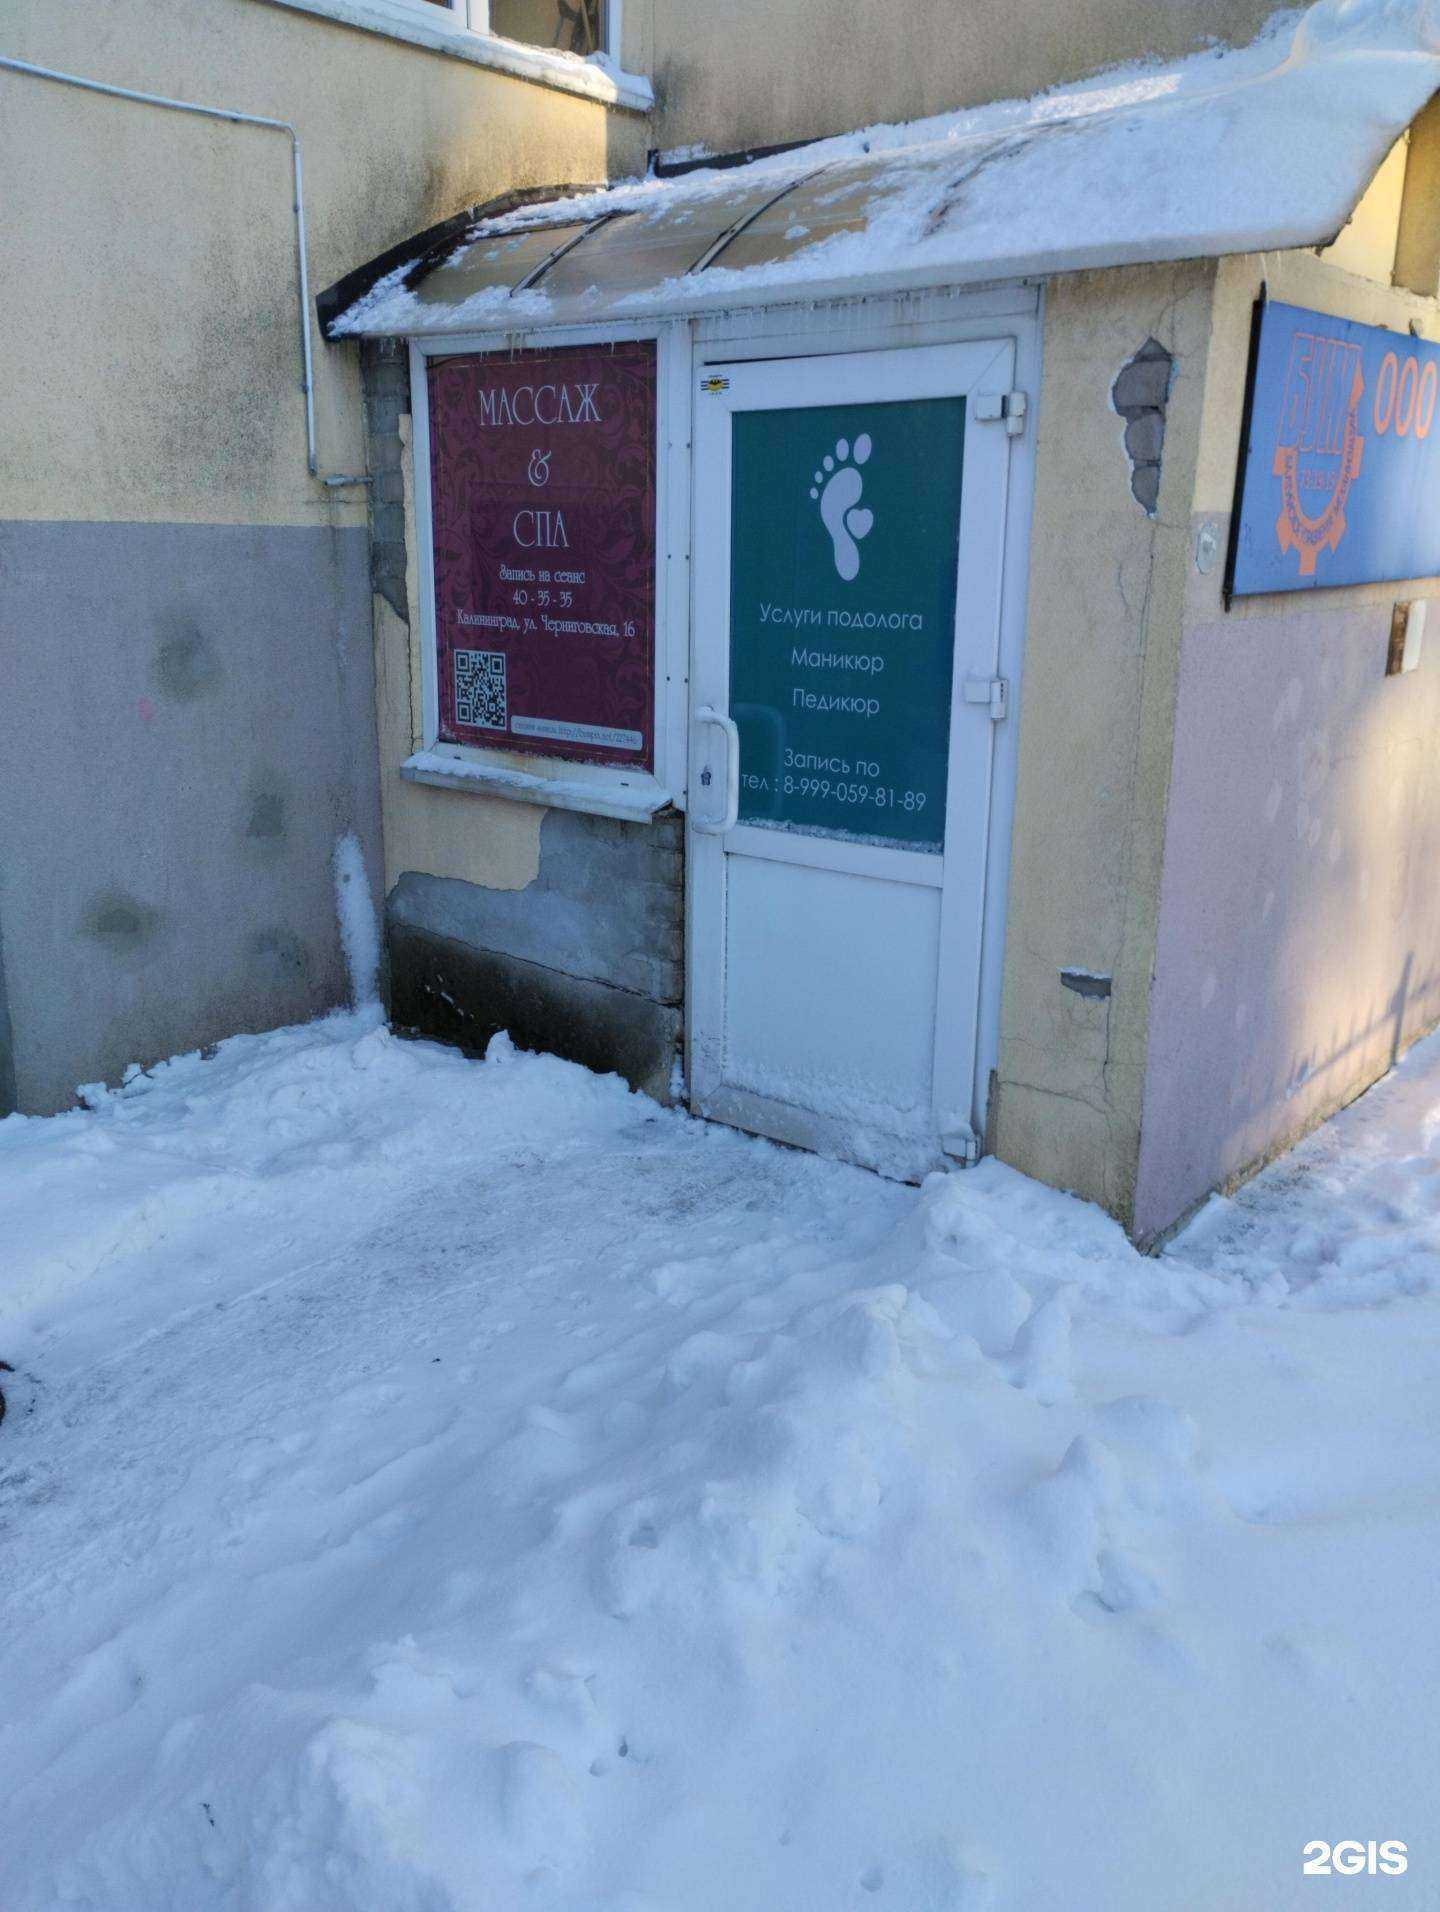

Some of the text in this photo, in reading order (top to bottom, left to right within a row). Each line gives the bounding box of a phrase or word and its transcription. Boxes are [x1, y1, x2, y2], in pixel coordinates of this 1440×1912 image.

[478, 383, 602, 426] МАССАЖ
[528, 448, 552, 487] &
[513, 510, 570, 548] СПА
[499, 564, 586, 584] Запись на сеанс
[623, 620, 636, 638] 16
[759, 603, 924, 631] Услуги подолога
[791, 647, 885, 675] Маникюр
[792, 688, 880, 717] Педикюр
[783, 748, 880, 778] Запись по
[783, 775, 927, 812] 8-999-059-81-89
